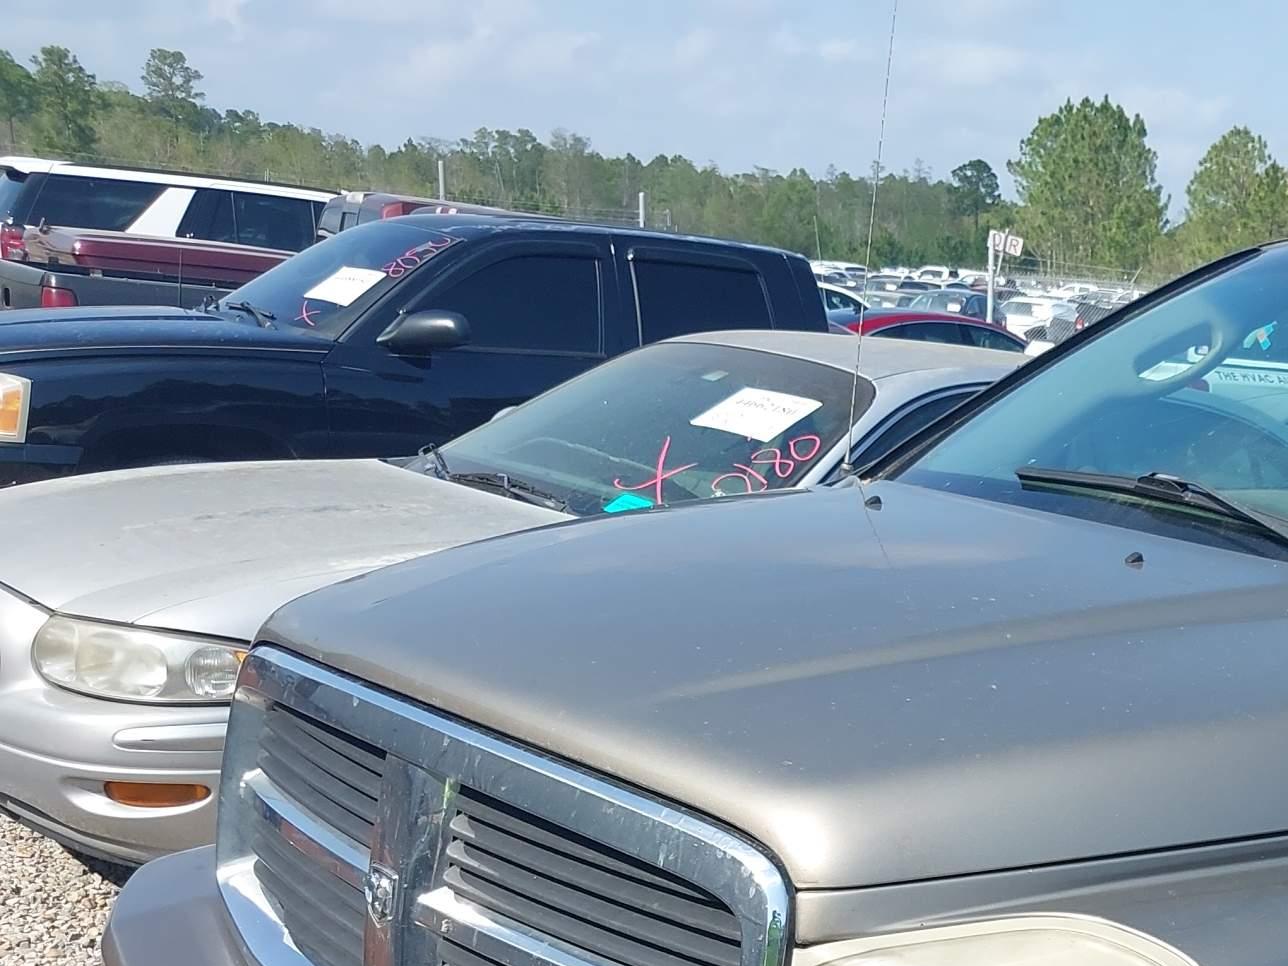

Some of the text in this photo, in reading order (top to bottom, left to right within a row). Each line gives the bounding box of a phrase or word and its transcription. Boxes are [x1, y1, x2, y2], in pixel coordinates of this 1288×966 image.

[1010, 239, 1020, 254] R
[1215, 370, 1240, 382] THE
[1241, 372, 1275, 384] HVAC
